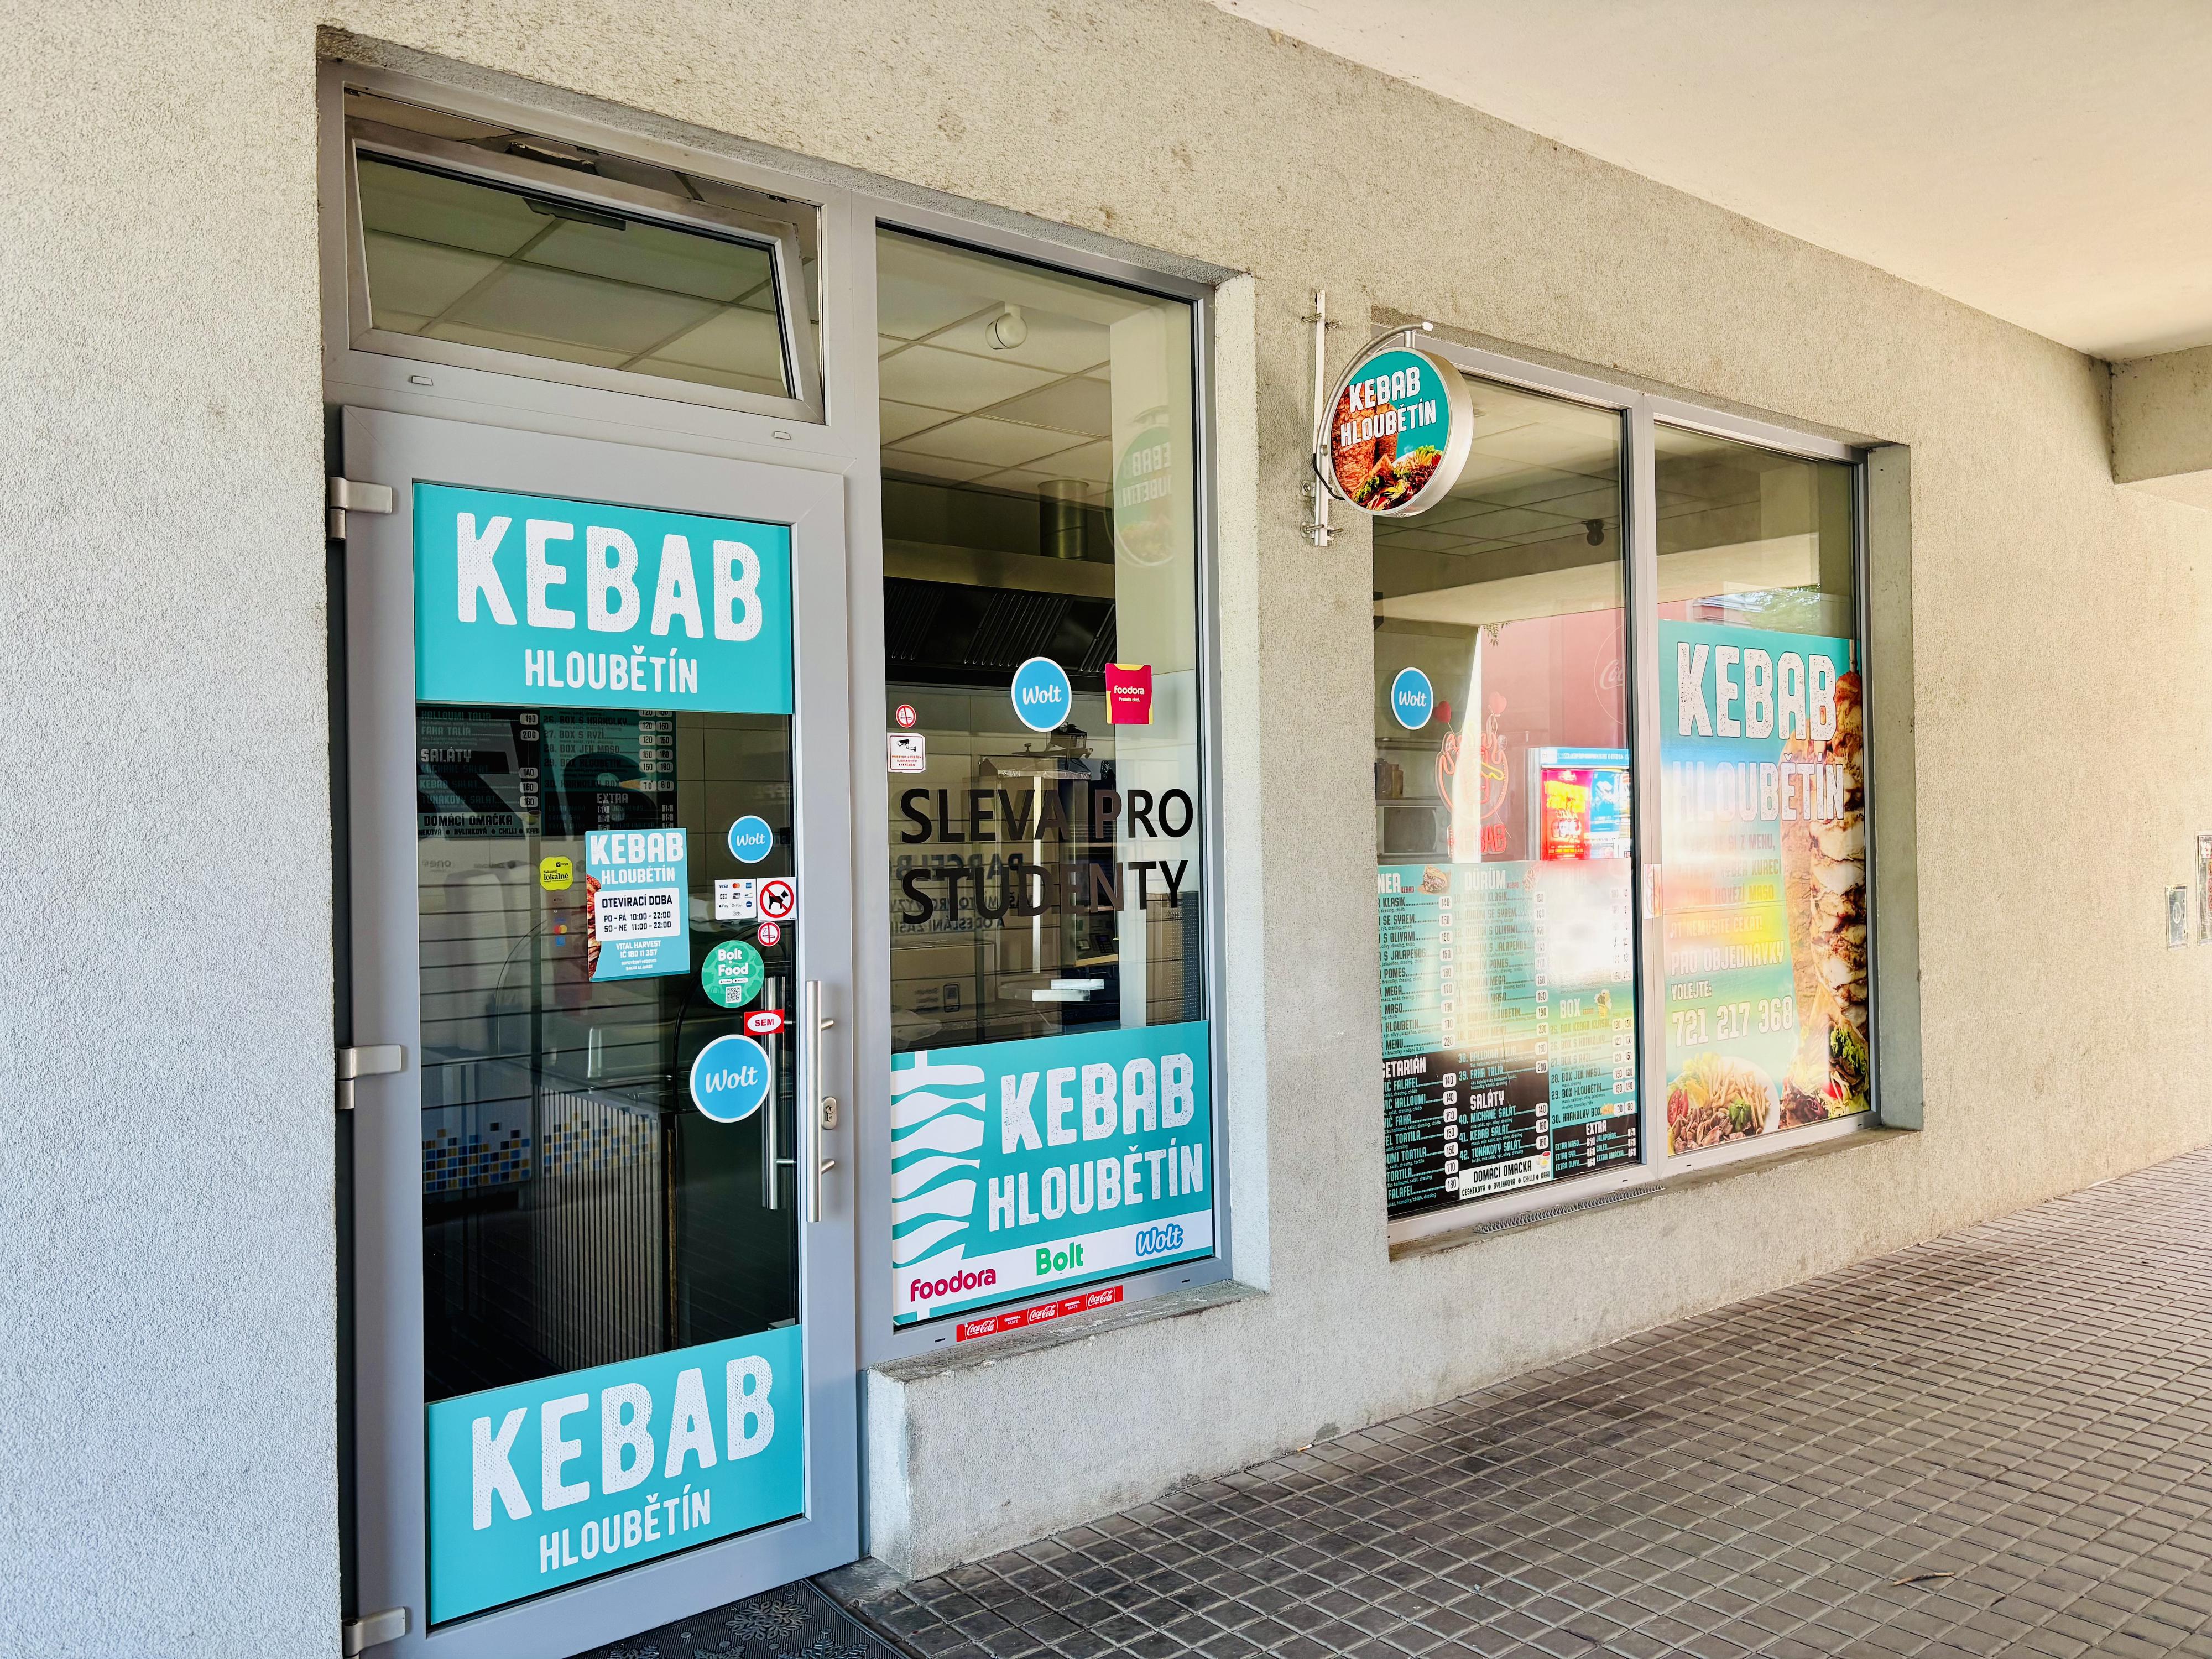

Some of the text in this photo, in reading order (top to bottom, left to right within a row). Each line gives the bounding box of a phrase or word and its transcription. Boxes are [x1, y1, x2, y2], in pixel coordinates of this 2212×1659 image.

[1349, 366, 1420, 413] KEBAB
[1340, 398, 1437, 447] HLOUBĚTÍN
[457, 512, 763, 641] KEBAB
[525, 645, 697, 693] HLOUBĚTÍN
[1022, 684, 1062, 705] Wolt
[1114, 685, 1145, 695] foodora
[1677, 641, 1838, 740] KEBAB
[1399, 690, 1427, 708] Wolt
[421, 747, 472, 763] SALÁTY
[1672, 752, 1844, 821] HLOUBĚTÍN
[900, 787, 1193, 844] SLEVA PRO
[591, 832, 684, 865] KEBAB
[736, 834, 765, 847] Wolt
[1749, 833, 1775, 851] MENU,
[602, 865, 675, 885] HLOUBĚTÍN
[902, 860, 1188, 925] STUDENTY
[1749, 885, 1774, 900] MASO
[602, 894, 672, 908] OTEVÍRACÍ DOBA
[1383, 896, 1406, 907] KLASIK
[619, 913, 626, 921] PÁ
[1383, 912, 1415, 925] SE SÝREM
[1384, 931, 1415, 943] S OLIVAMI
[718, 948, 742, 961] Bolt
[1384, 951, 1388, 961] S
[1671, 940, 1785, 976] PRO OBJEDNÁVKY
[718, 963, 749, 976] Food
[1384, 967, 1406, 979] POMES
[1385, 985, 1402, 997] MEGA
[1671, 980, 1712, 1001] VOLEJTE:
[1385, 1003, 1402, 1014] MASO
[1560, 998, 1581, 1019] BOX
[755, 1018, 774, 1026] SEM
[1672, 996, 1794, 1047] 721 217 368
[1386, 1038, 1403, 1050] MENU
[706, 1066, 758, 1093] Wolt
[1394, 1077, 1418, 1091] FALAFEL
[1459, 1071, 1468, 1081] 39.
[1551, 1068, 1600, 1084] 28. BOX JEN MASO
[1395, 1094, 1426, 1108] HALLOUMI
[1470, 1089, 1504, 1110] SALÁTY
[1552, 1091, 1560, 1100] 29.
[1562, 1088, 1572, 1098] BOX
[1001, 1053, 1194, 1155] KEBAB
[1395, 1114, 1411, 1126] FAHA
[1459, 1114, 1468, 1125] 40.
[1552, 1107, 1601, 1124] 30. HRANOLKY BOX
[1459, 1124, 1509, 1142] 41. KEBAB SALÁT
[1586, 1120, 1607, 1135] EXTRA
[1395, 1130, 1421, 1144] TORTILA
[1401, 1147, 1427, 1161] TORTILA
[1460, 1150, 1469, 1160] 42.
[1503, 1140, 1521, 1151] SALÁT
[1597, 1153, 1608, 1162] EXTRA
[1386, 1167, 1412, 1182] TORTILA
[1474, 1164, 1500, 1183] DOMÁCÍ
[1556, 1162, 1567, 1171] EXTRA
[989, 1137, 1203, 1232] HLOUBĚTÍN
[1388, 1185, 1413, 1200] FALAFEL
[910, 1223, 1183, 1302] foodora Bolt Wolt
[472, 1355, 774, 1531] KEBAB
[540, 1484, 711, 1573] HLOUBĚTÍN
